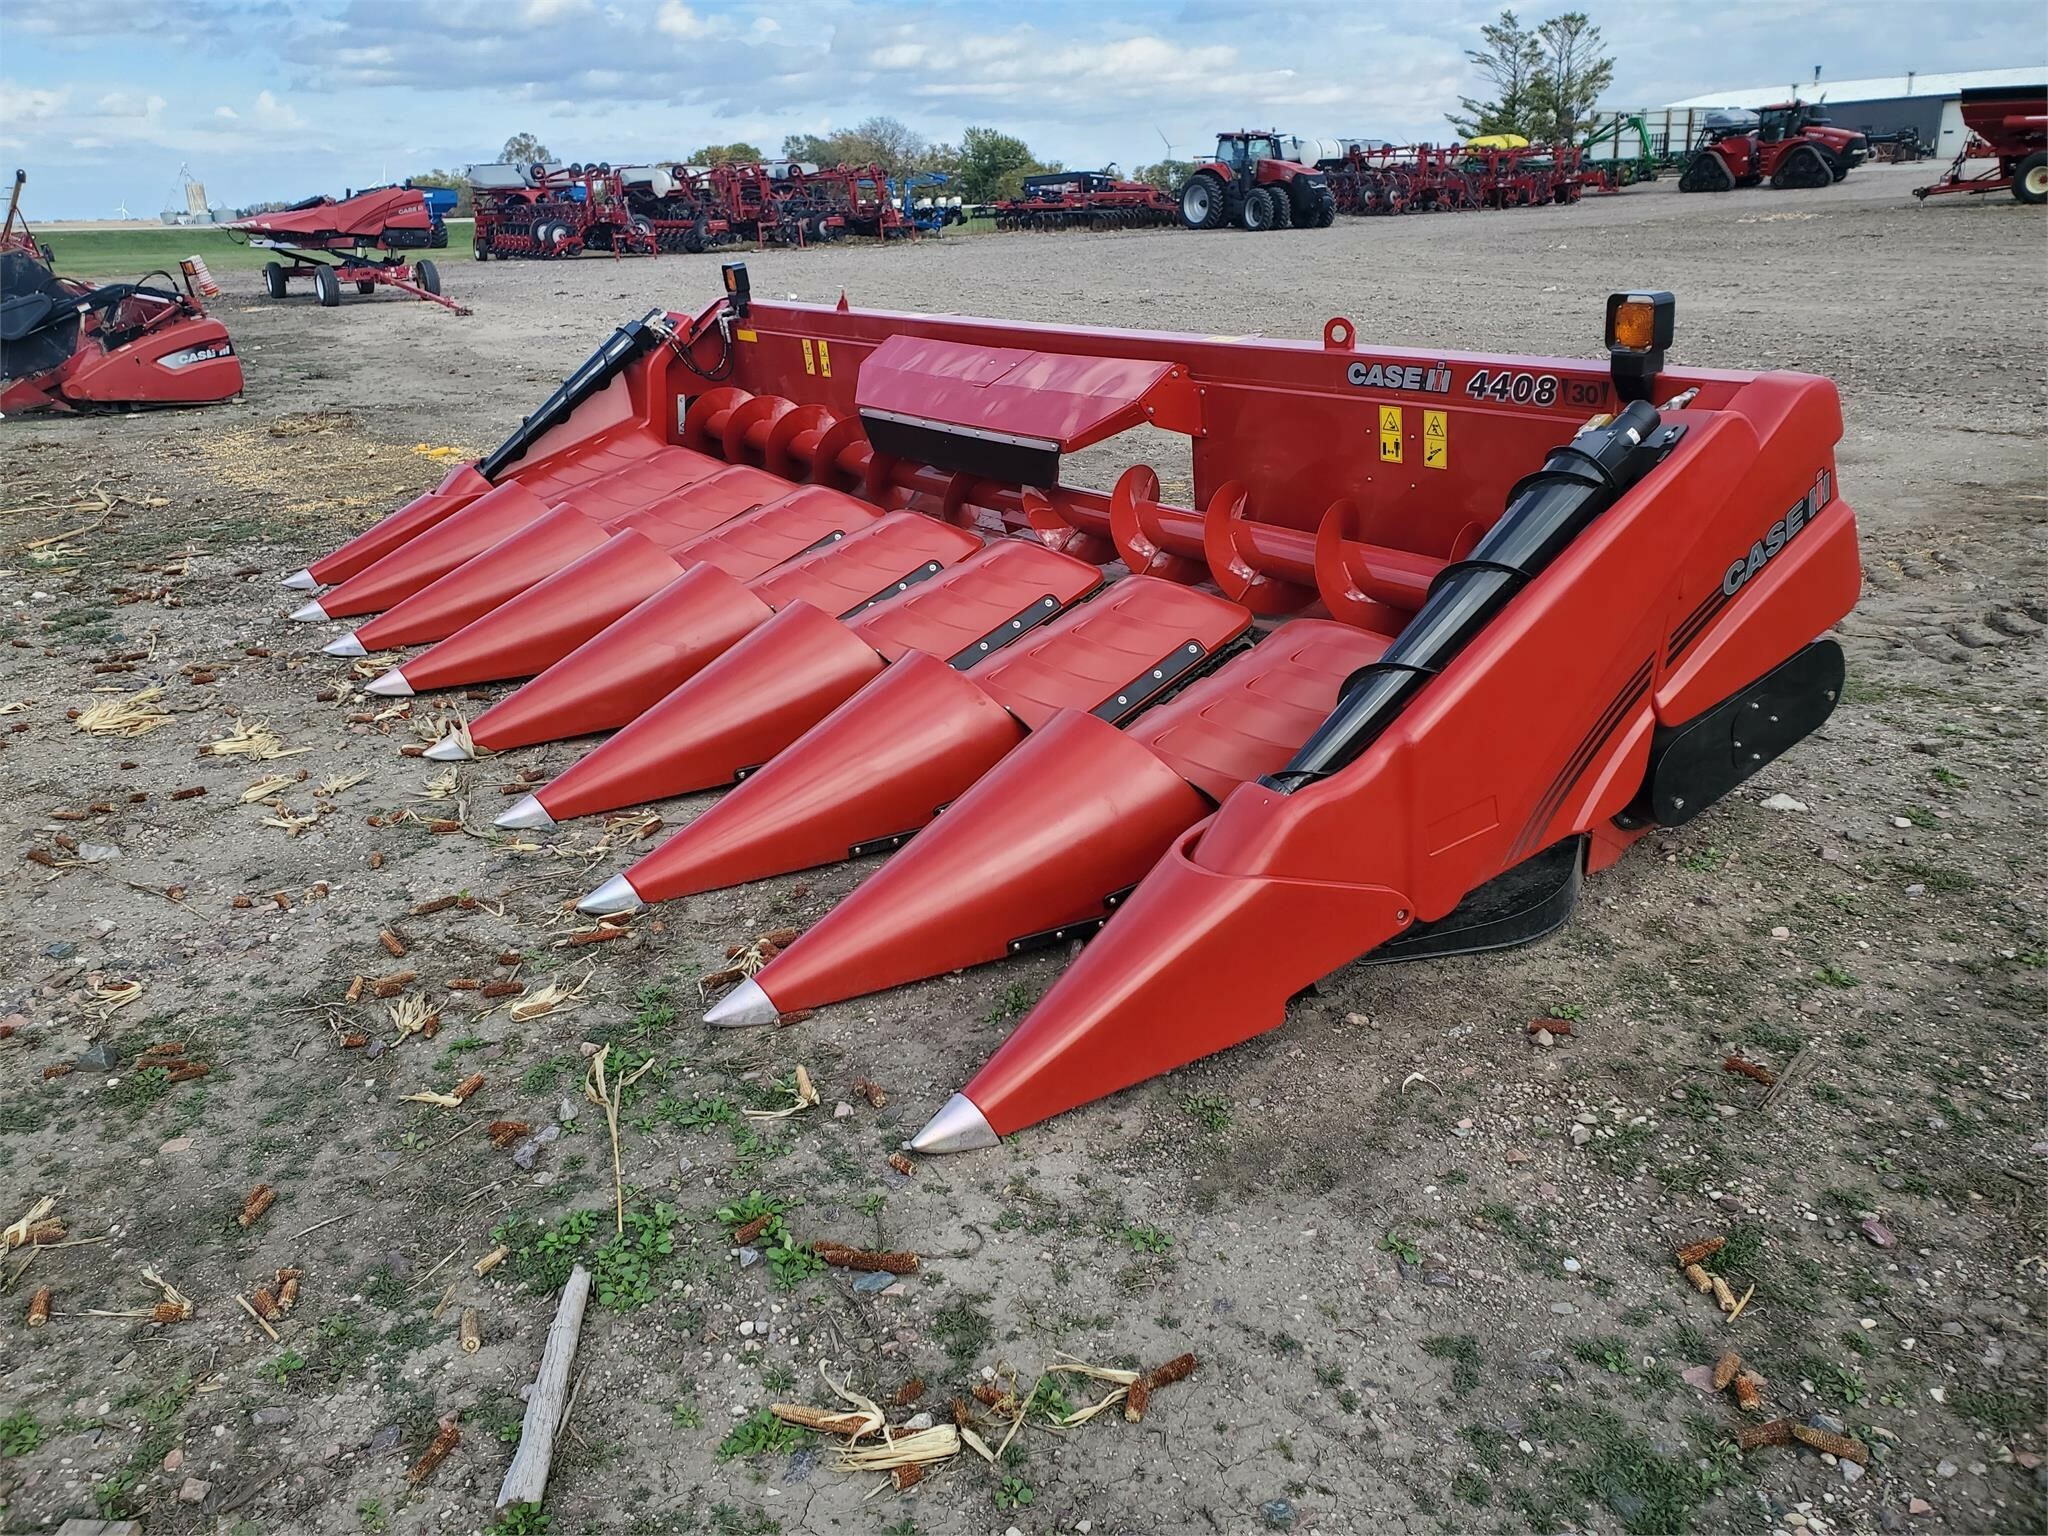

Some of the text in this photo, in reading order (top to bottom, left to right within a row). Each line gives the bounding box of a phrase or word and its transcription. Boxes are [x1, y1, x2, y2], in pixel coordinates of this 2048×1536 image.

[398, 206, 417, 215] CASE
[1347, 361, 1423, 390] CASE
[1465, 369, 1558, 407] 4408
[1571, 383, 1600, 405] 30
[1722, 498, 1804, 596] CASE
